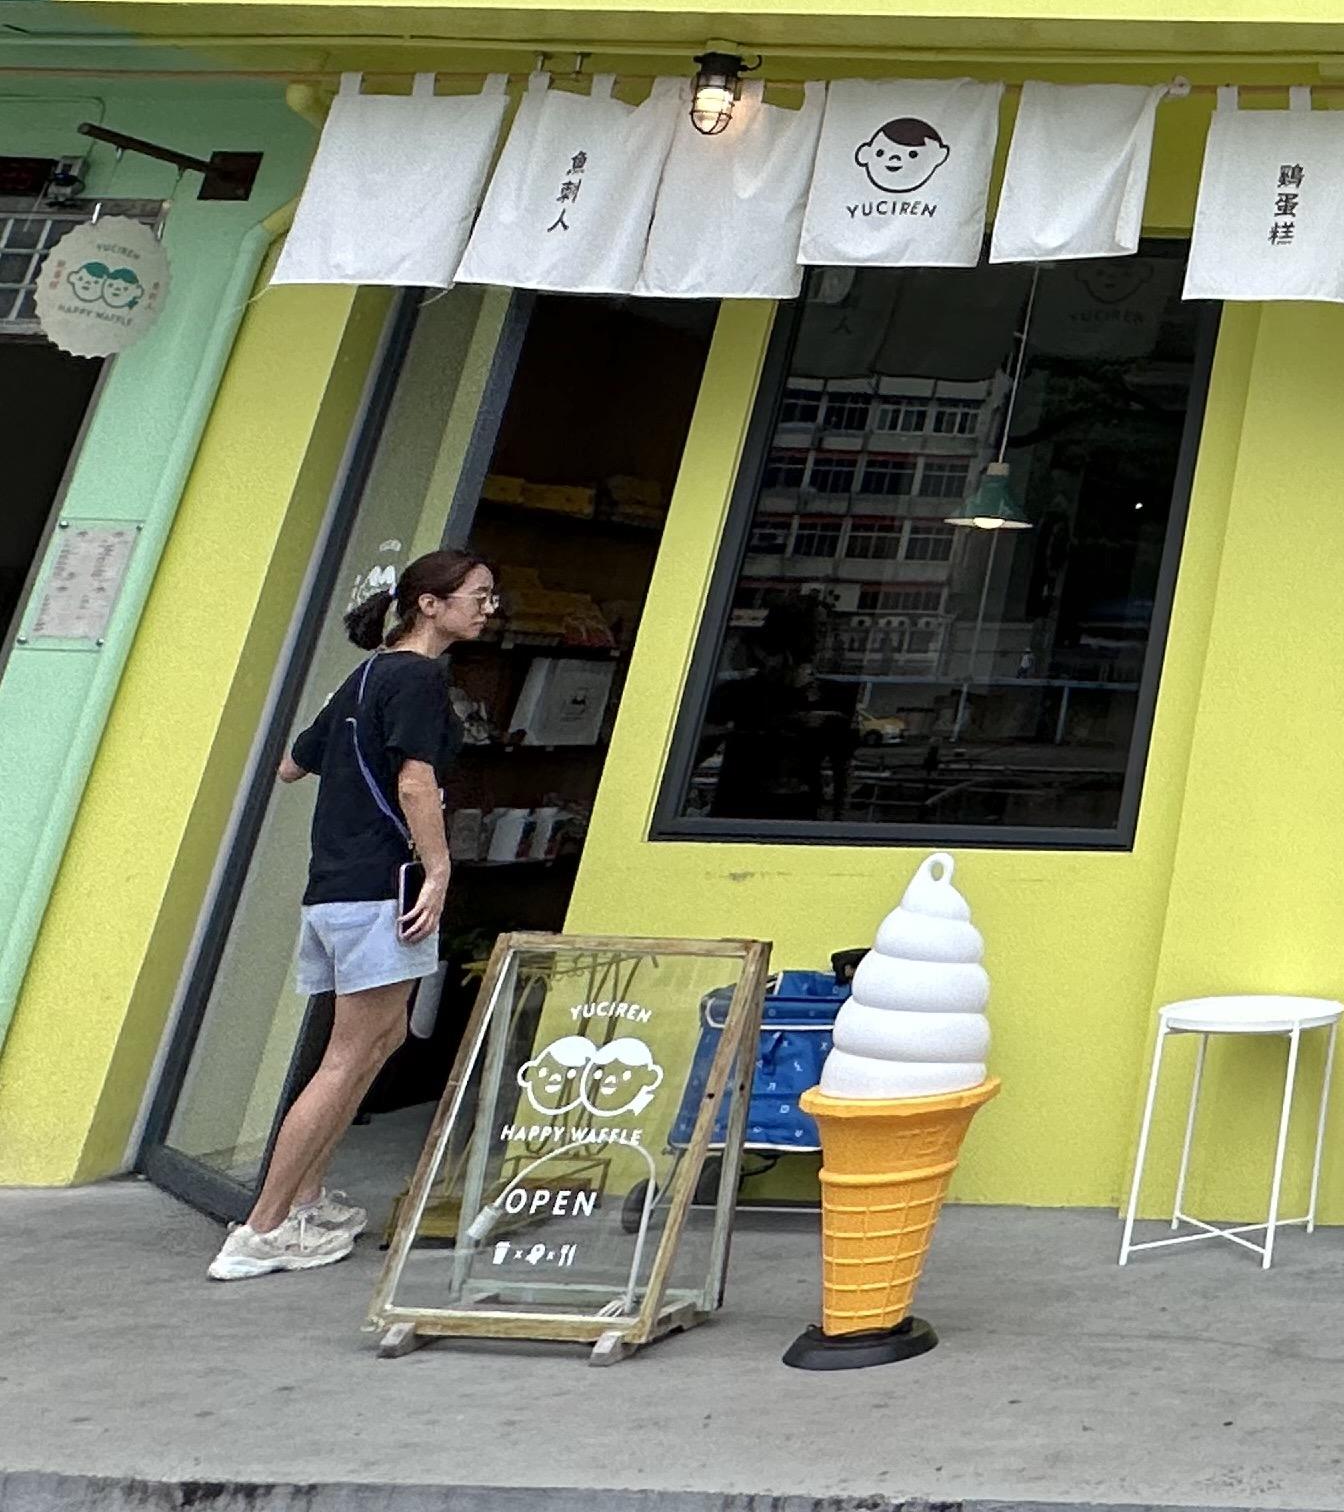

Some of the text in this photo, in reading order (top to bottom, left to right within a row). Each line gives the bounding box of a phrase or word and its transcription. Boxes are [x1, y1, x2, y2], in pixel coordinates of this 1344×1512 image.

[547, 151, 587, 233] 魚刺人
[846, 200, 938, 219] YUCIREN
[570, 1001, 653, 1023] YUCIREN
[500, 1124, 644, 1145] HAPPY WAFFLE
[504, 1188, 598, 1217] OPEN
